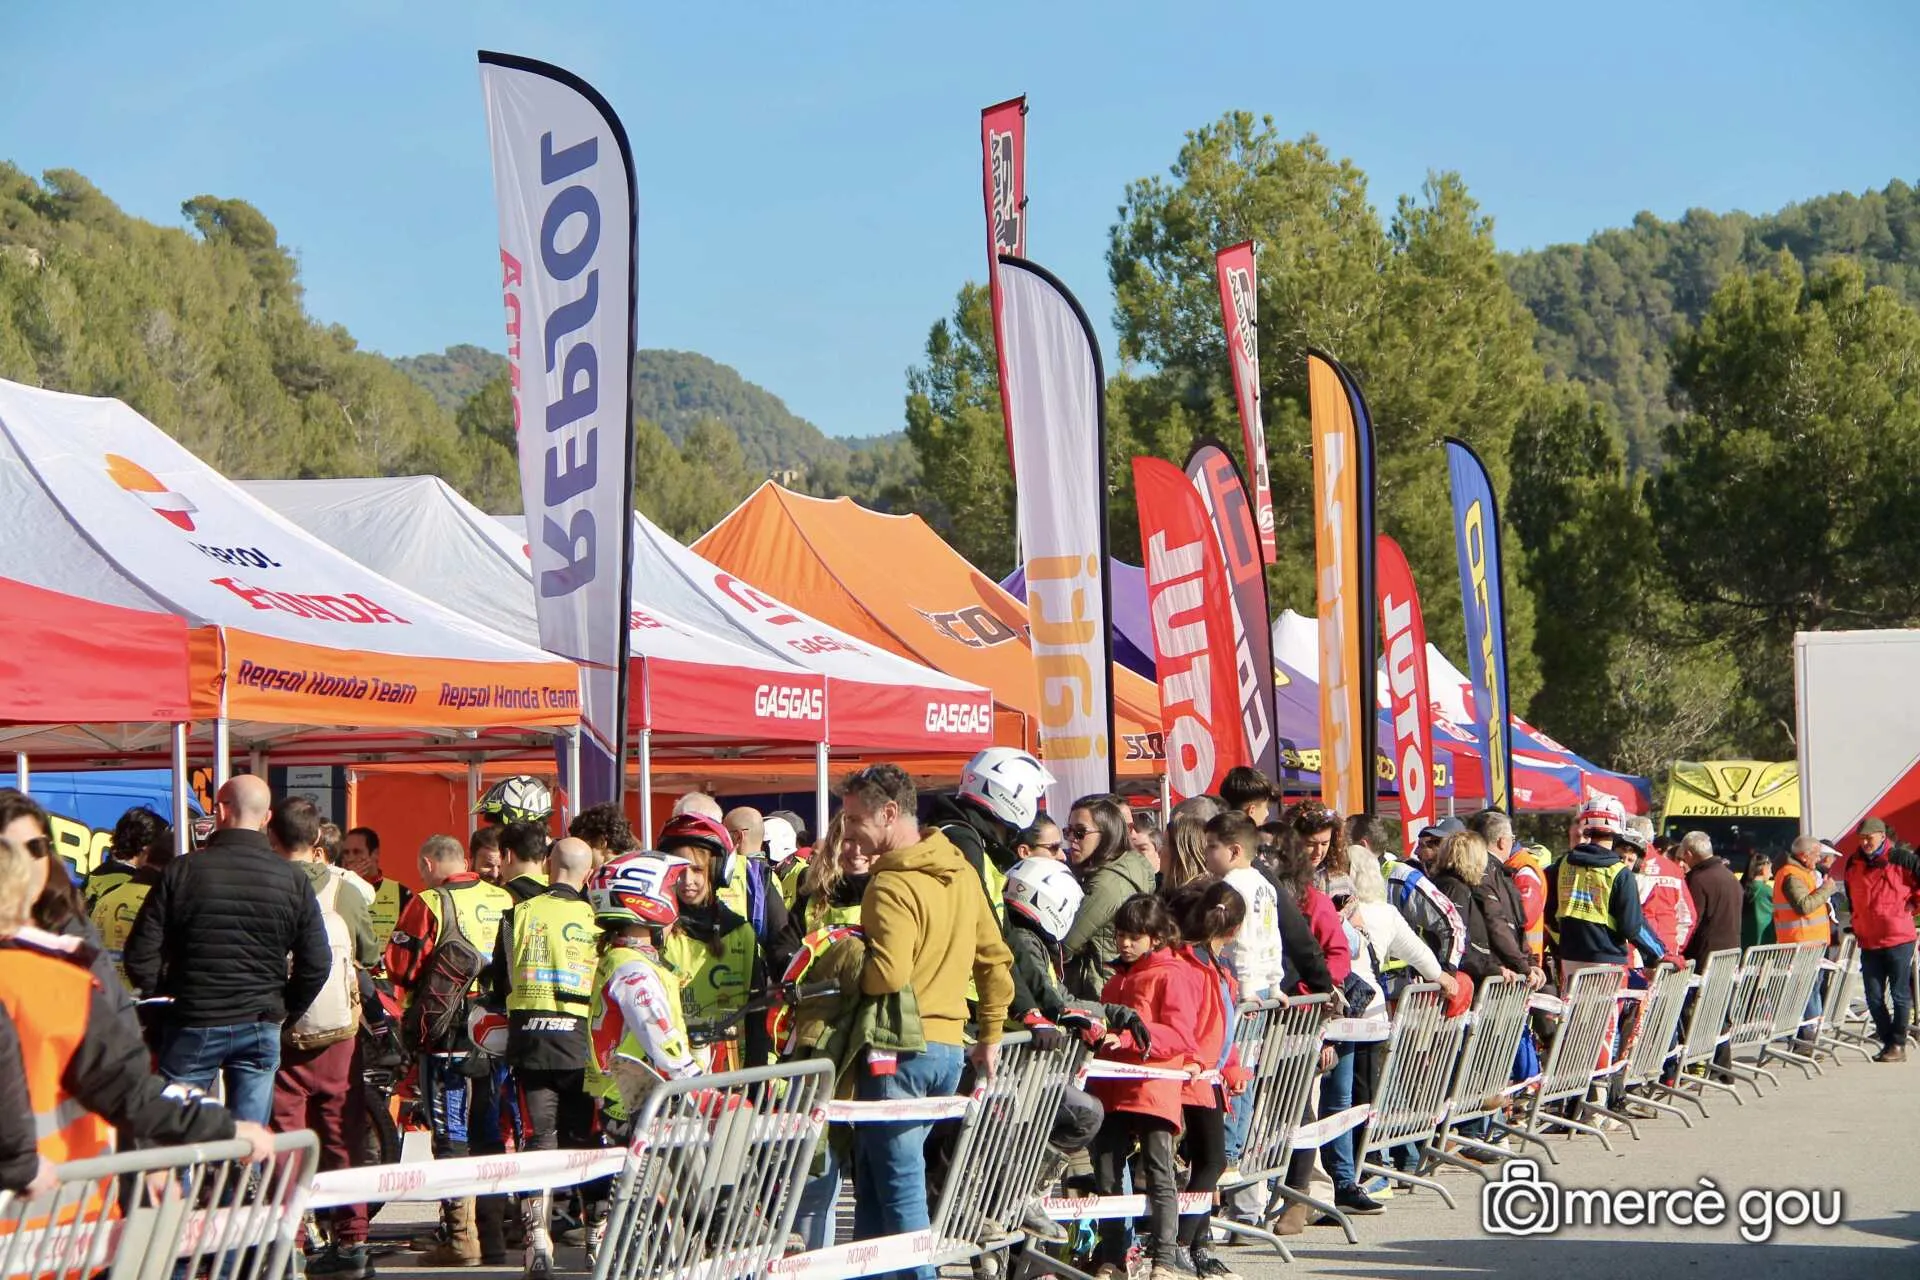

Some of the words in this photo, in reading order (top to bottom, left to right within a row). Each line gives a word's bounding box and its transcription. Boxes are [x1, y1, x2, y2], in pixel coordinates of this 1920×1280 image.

[208, 576, 413, 625] HONDA
[237, 660, 307, 694] Repsol
[305, 671, 368, 699] Honda
[369, 677, 417, 705] Team
[438, 683, 490, 711] Repsol
[495, 686, 540, 709] Honda
[543, 687, 578, 709] Team
[755, 684, 823, 721] GASGAS
[925, 702, 990, 733] GASGAS
[1121, 732, 1166, 761] SCO
[522, 1017, 578, 1031] JITSIE
